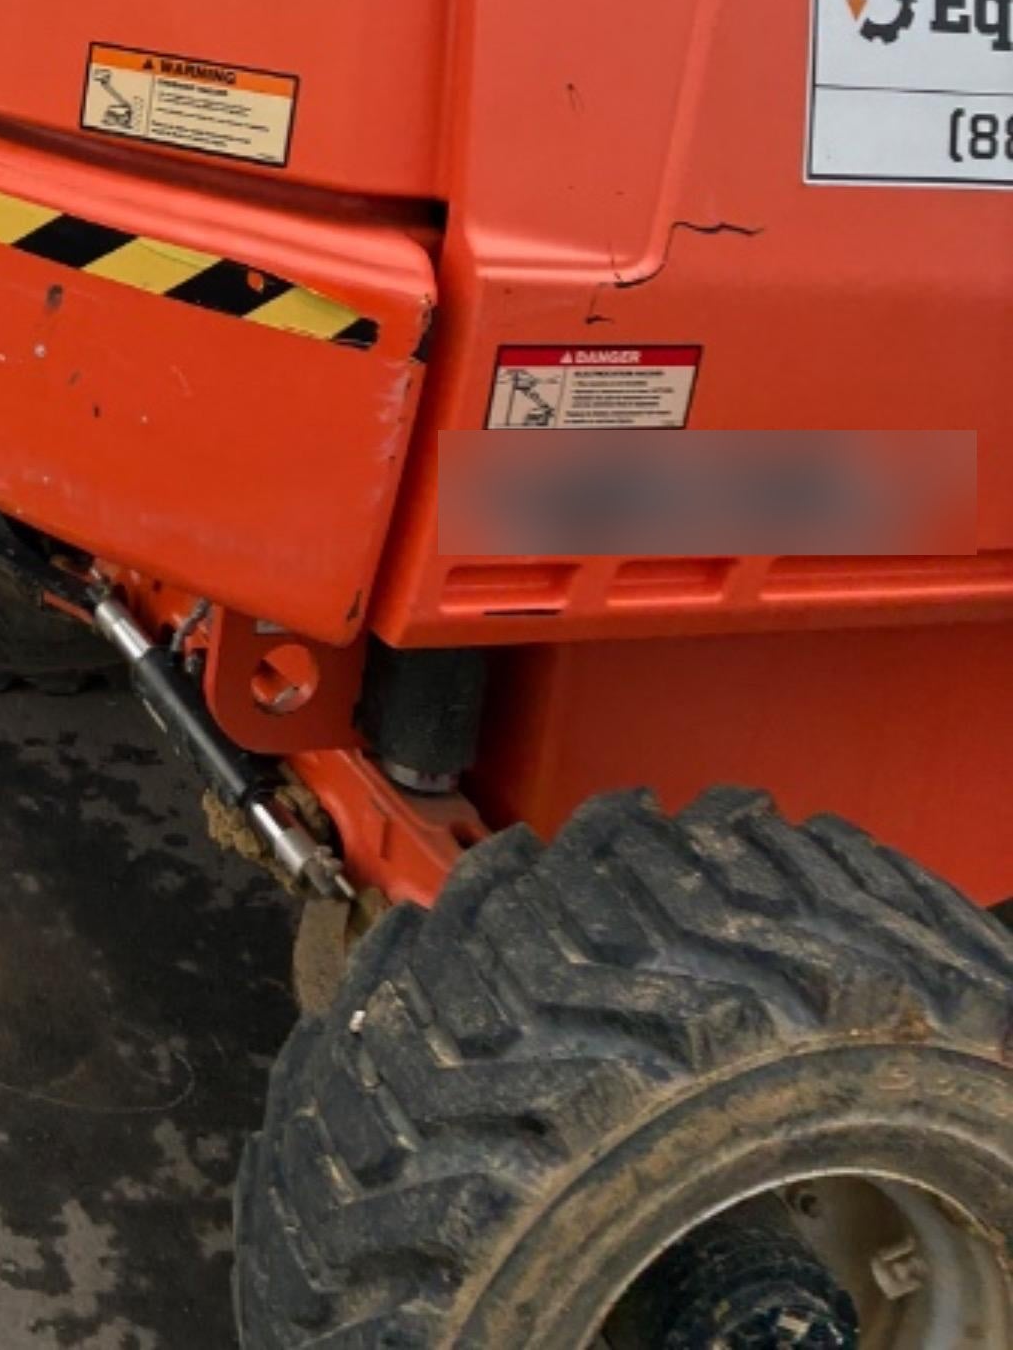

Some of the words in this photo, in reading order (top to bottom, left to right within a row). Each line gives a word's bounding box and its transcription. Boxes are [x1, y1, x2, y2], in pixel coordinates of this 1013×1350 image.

[160, 59, 236, 85] WARNING
[948, 107, 1013, 163] (8
[574, 350, 642, 364] DANGER
